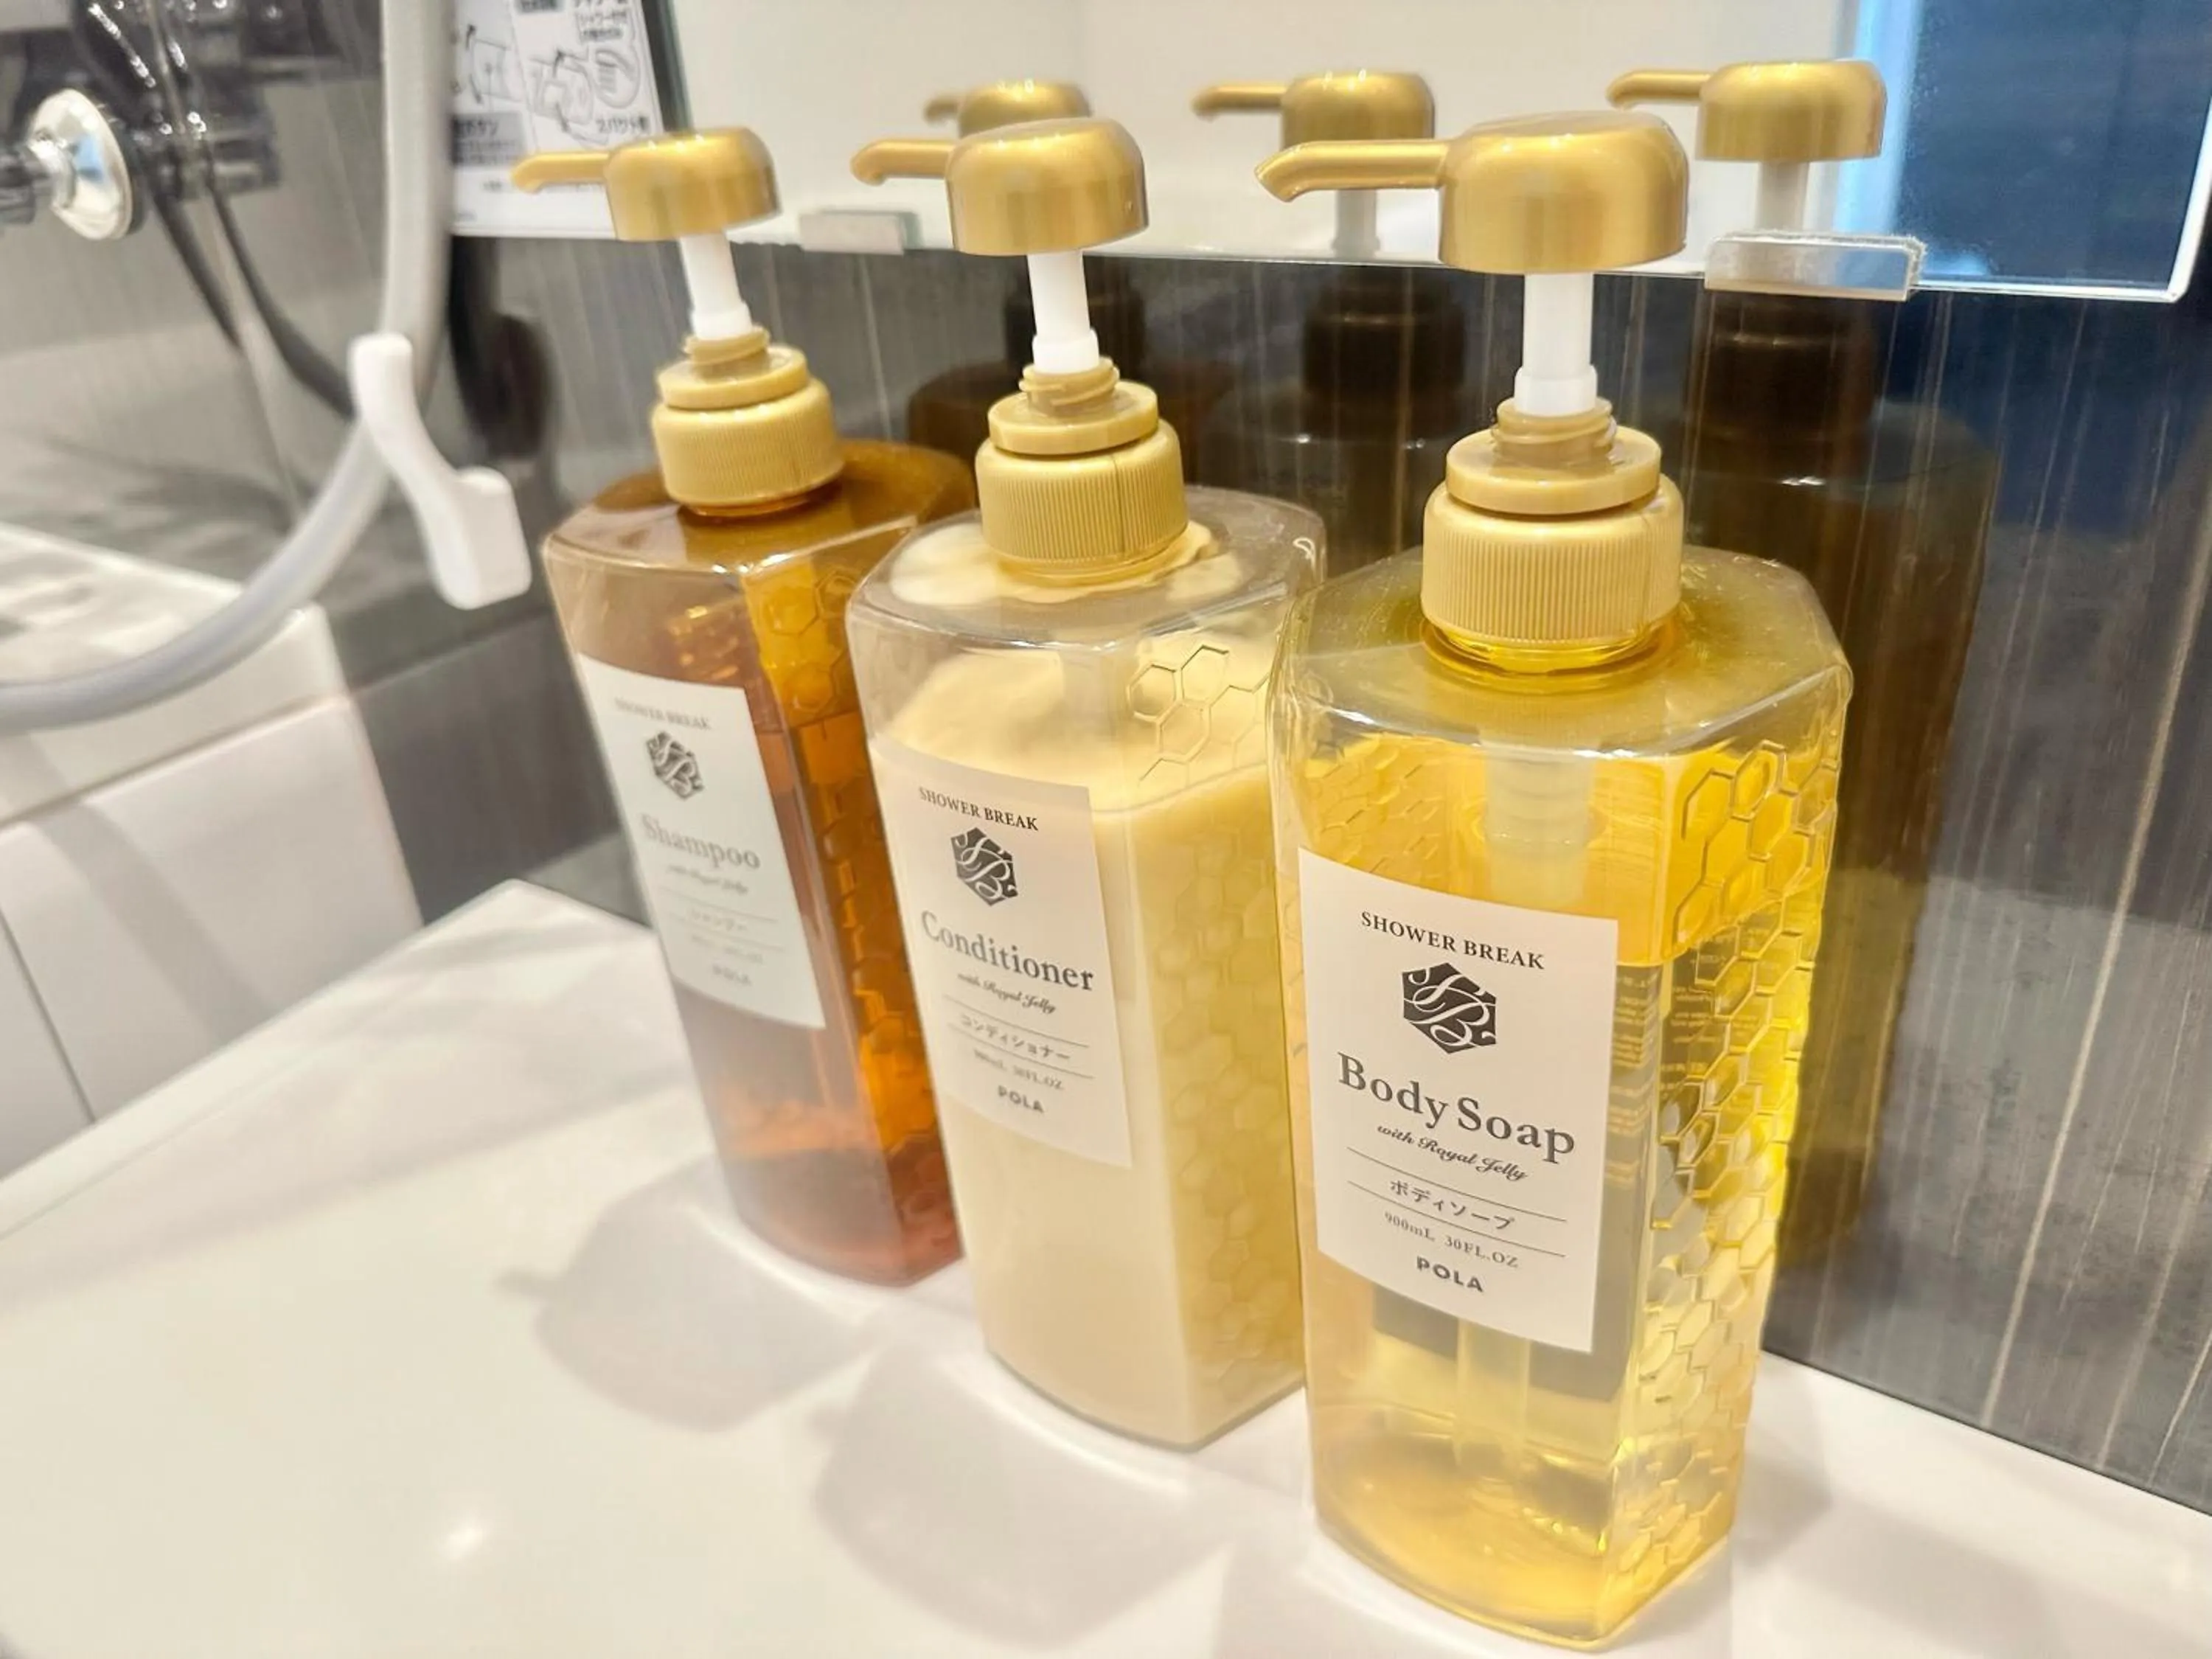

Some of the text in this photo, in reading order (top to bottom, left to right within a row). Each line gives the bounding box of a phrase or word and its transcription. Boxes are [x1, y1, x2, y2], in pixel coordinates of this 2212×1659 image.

[919, 786, 1039, 831] SHOWER BREAK
[641, 813, 761, 870] Shampoo
[922, 910, 1094, 991] Conditioner
[1361, 910, 1545, 970] SHOWER BREAK
[998, 1084, 1045, 1114] POLA
[1337, 1051, 1450, 1129] Body
[1456, 1096, 1575, 1164] Soap
[1377, 1124, 1528, 1182] with Royal Jelly
[1385, 1211, 1436, 1242] 900mL
[1390, 1180, 1515, 1230] ボディソープ
[1416, 1255, 1484, 1293] POLA
